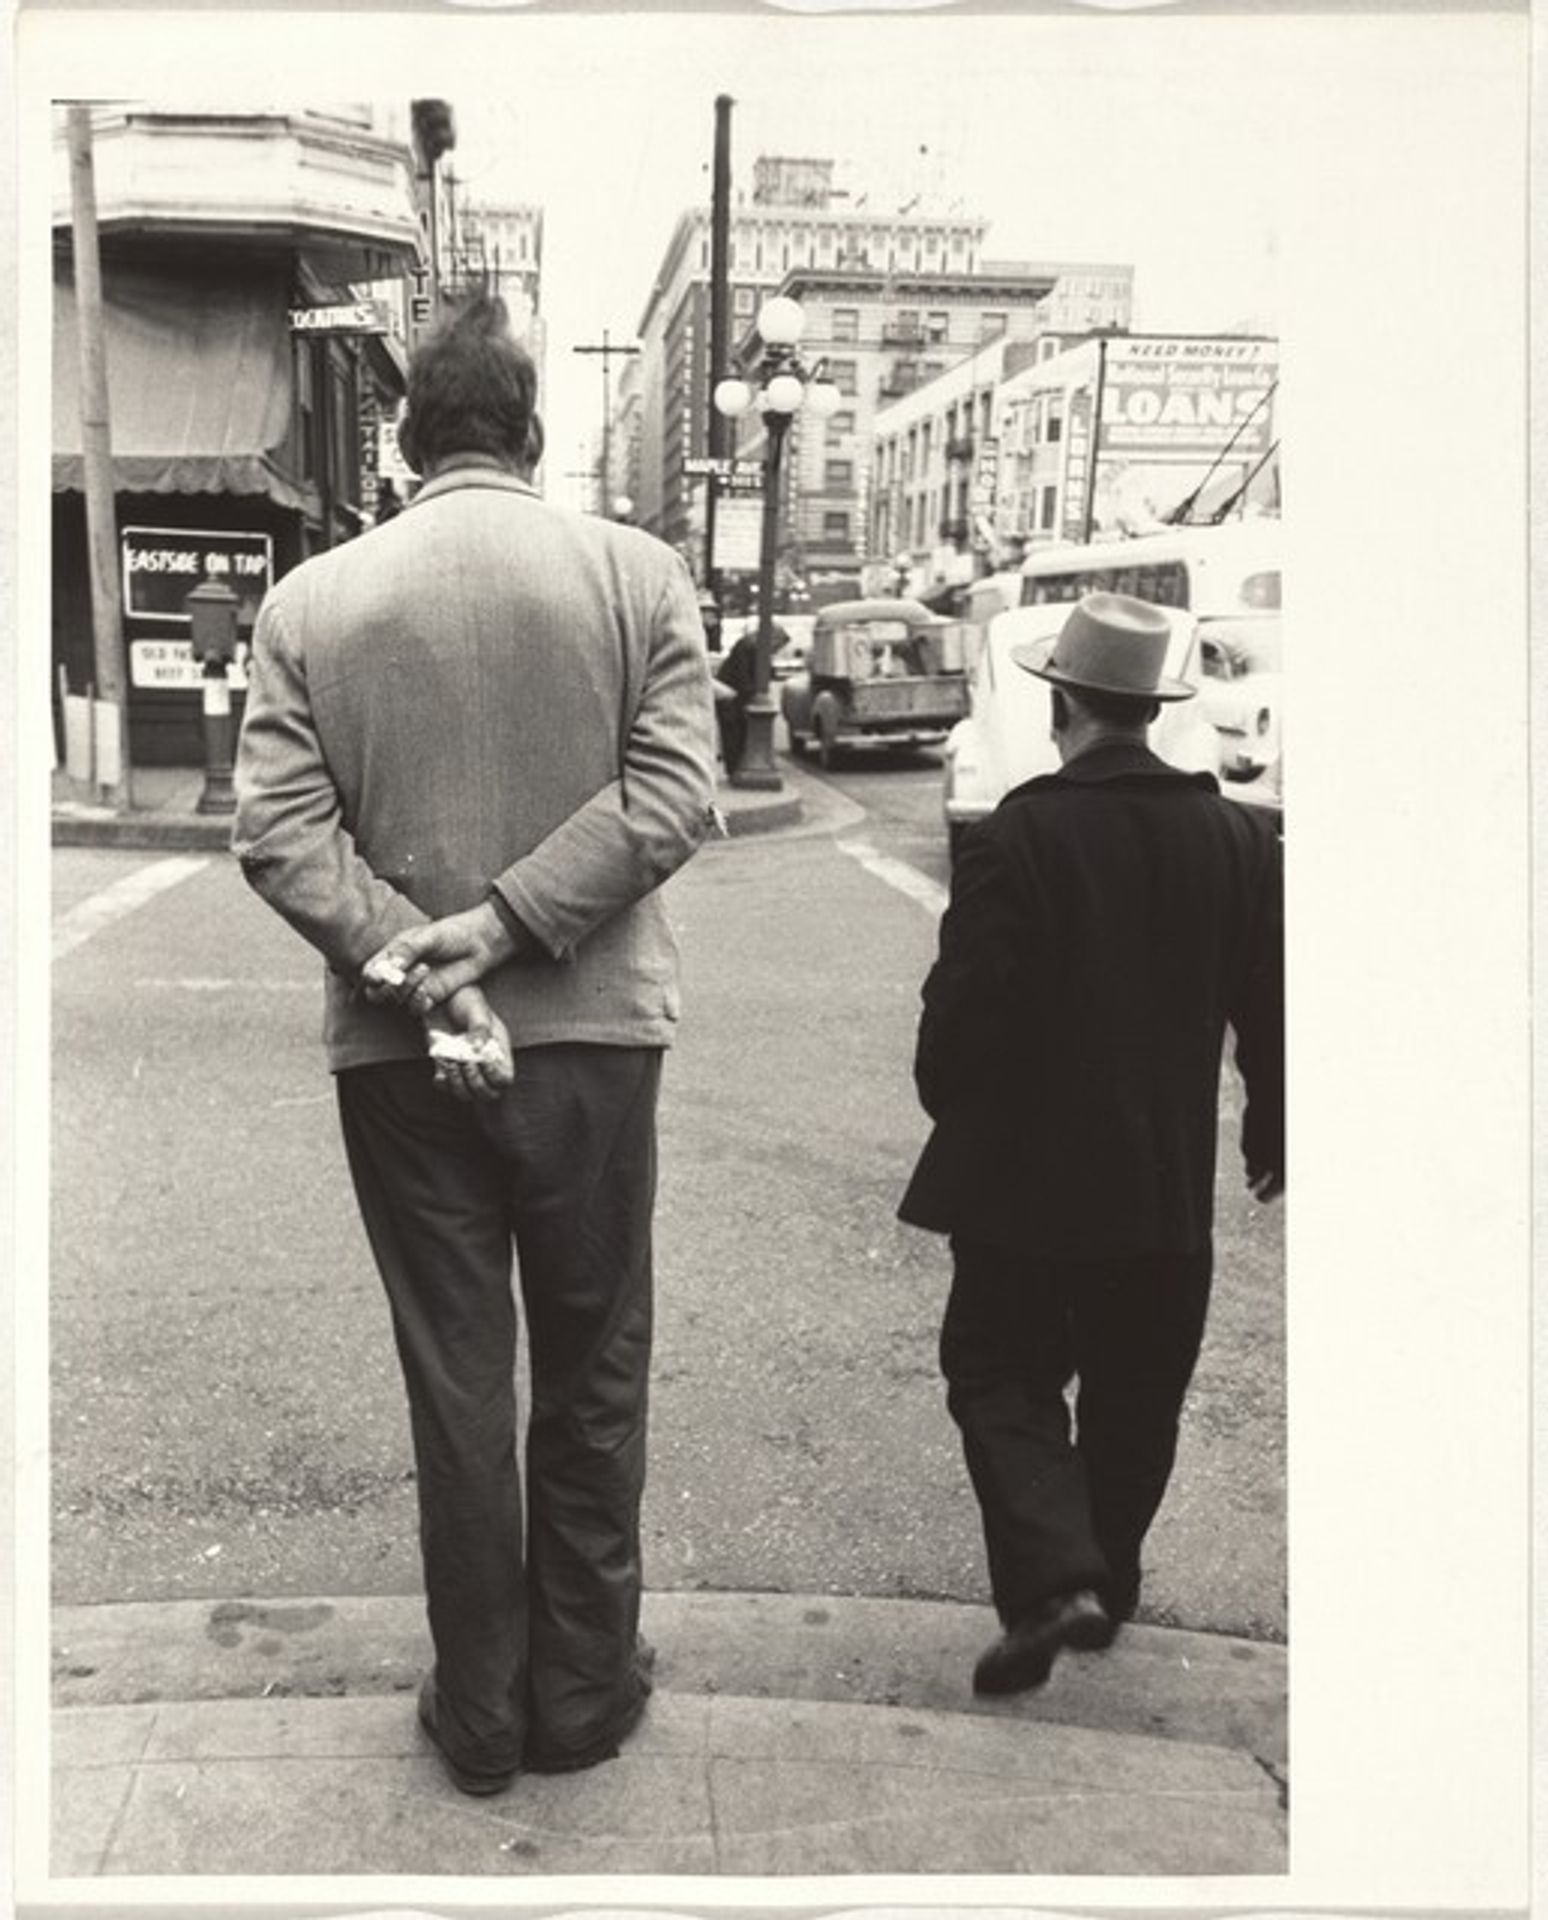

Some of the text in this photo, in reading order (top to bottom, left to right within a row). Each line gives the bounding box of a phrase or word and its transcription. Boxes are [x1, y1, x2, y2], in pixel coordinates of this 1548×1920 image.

[1130, 344, 1178, 357] NEED
[1101, 387, 1269, 426] LOANS
[126, 550, 267, 575] EASTSIDE ON TAP
